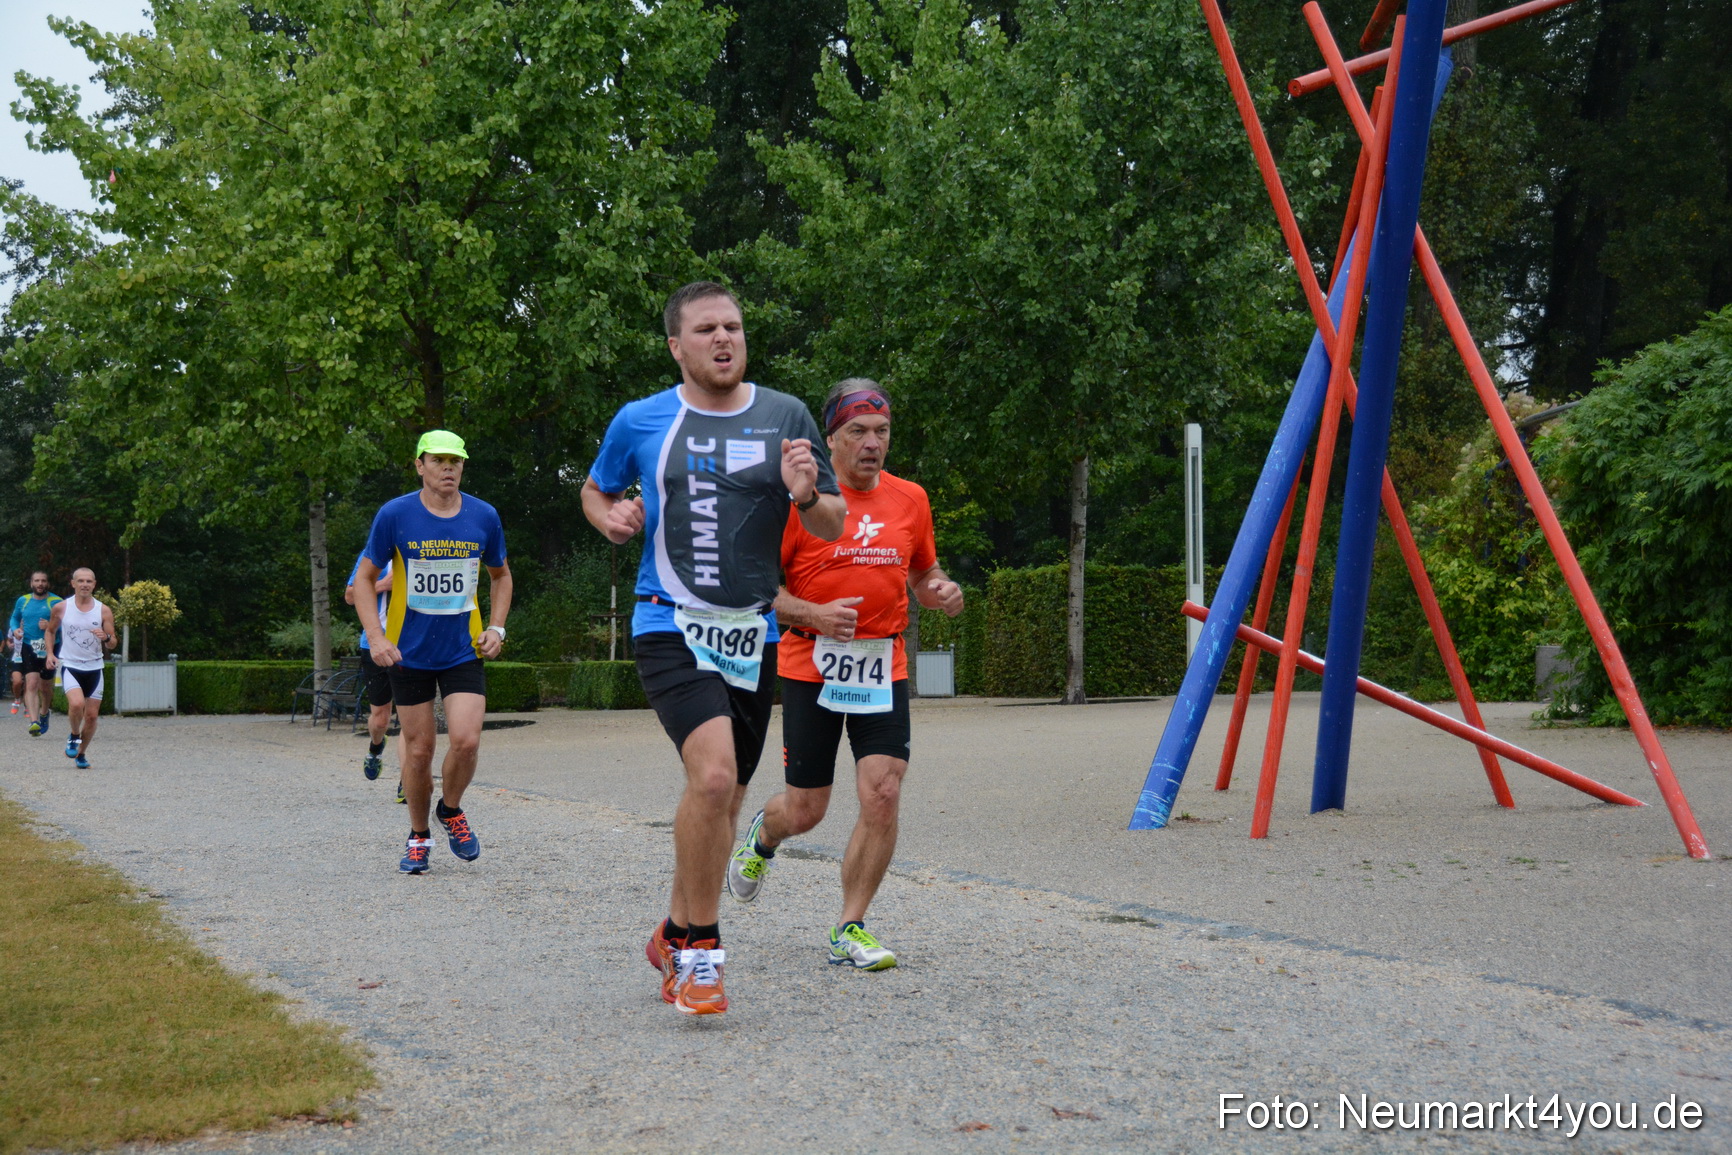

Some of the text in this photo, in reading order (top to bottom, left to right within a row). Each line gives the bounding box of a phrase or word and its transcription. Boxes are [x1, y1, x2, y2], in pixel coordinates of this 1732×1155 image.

[687, 436, 721, 587] HIMATEC
[407, 540, 479, 551] 10. NEUMARKTER
[419, 549, 470, 558] STADTLAUF
[833, 546, 897, 558] funrunners
[414, 572, 464, 594] 3056
[686, 622, 759, 658] 2098
[821, 652, 884, 685] 2614
[831, 689, 871, 703] Hartmut
